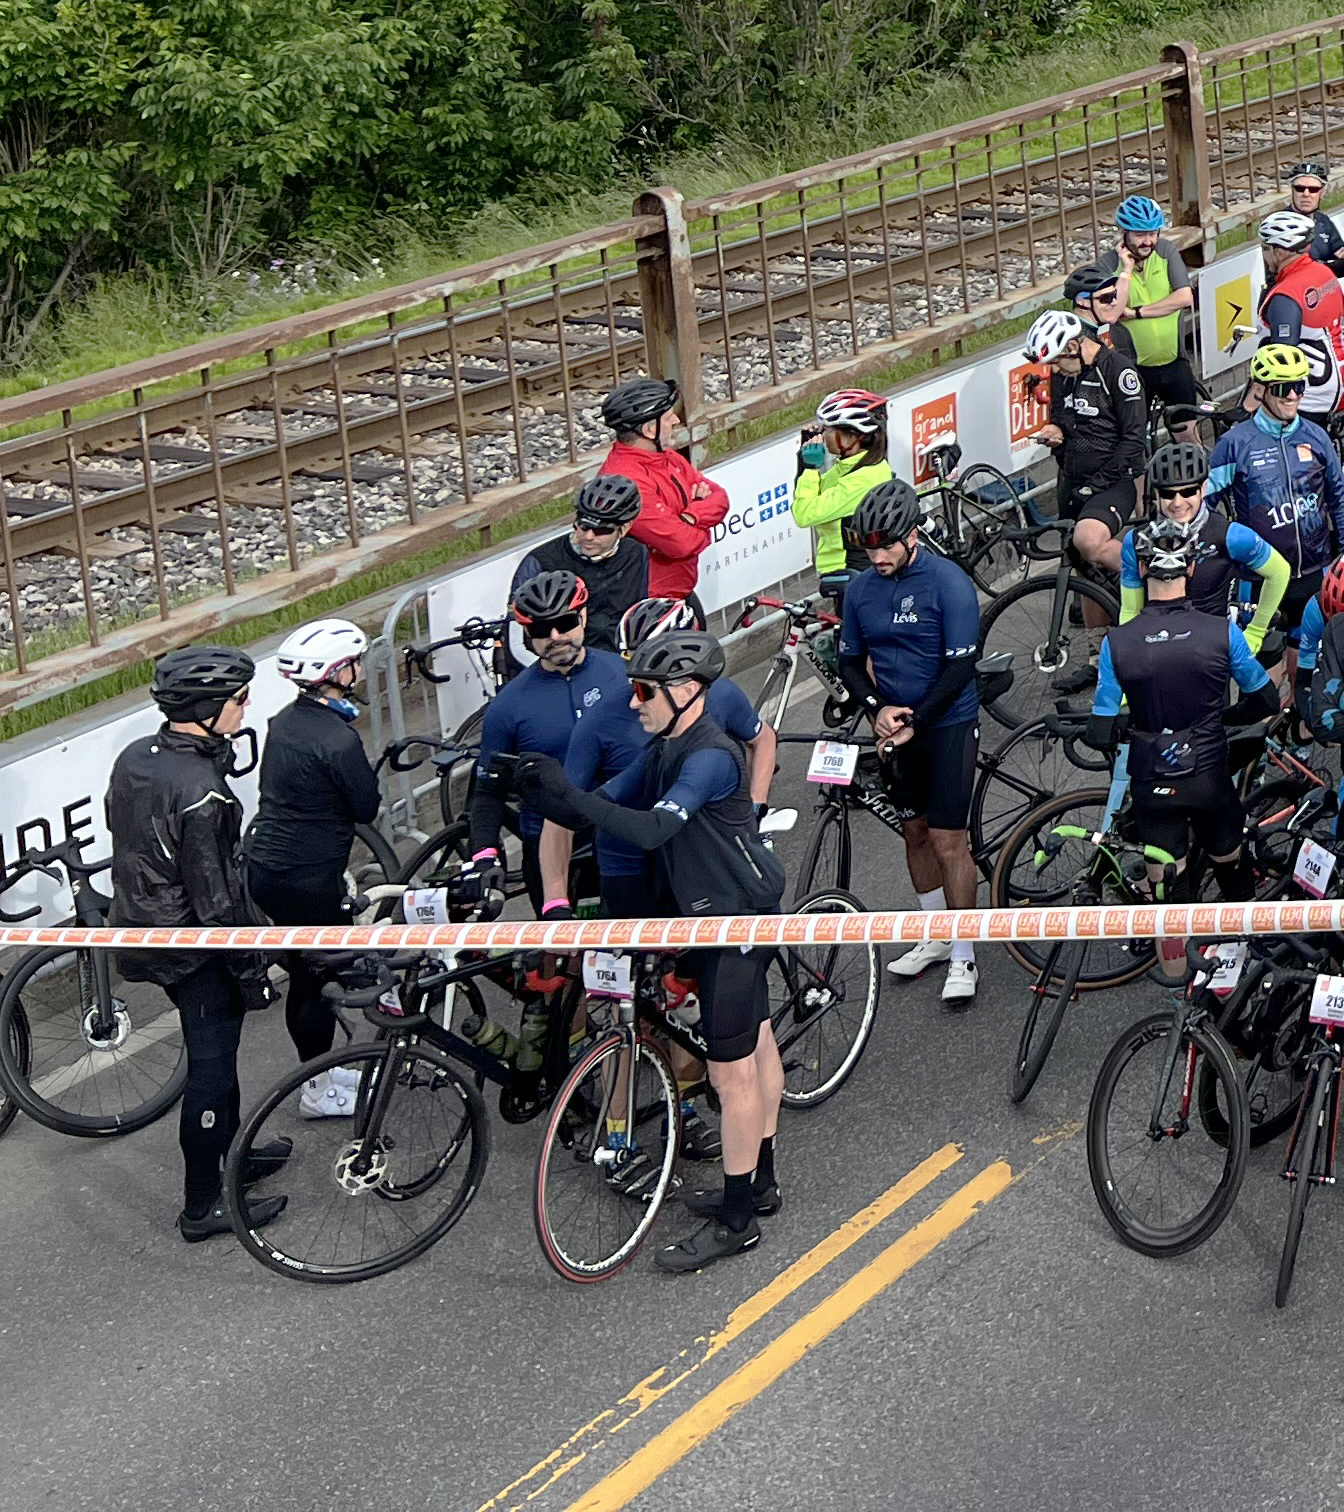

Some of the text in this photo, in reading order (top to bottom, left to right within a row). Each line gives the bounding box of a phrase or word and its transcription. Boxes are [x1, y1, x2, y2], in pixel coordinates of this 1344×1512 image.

[914, 403, 954, 442] grand
[705, 527, 793, 576] PARTENAIRE
[893, 612, 918, 623] Lévis
[805, 650, 838, 685] ARGON
[596, 970, 617, 981] 176A
